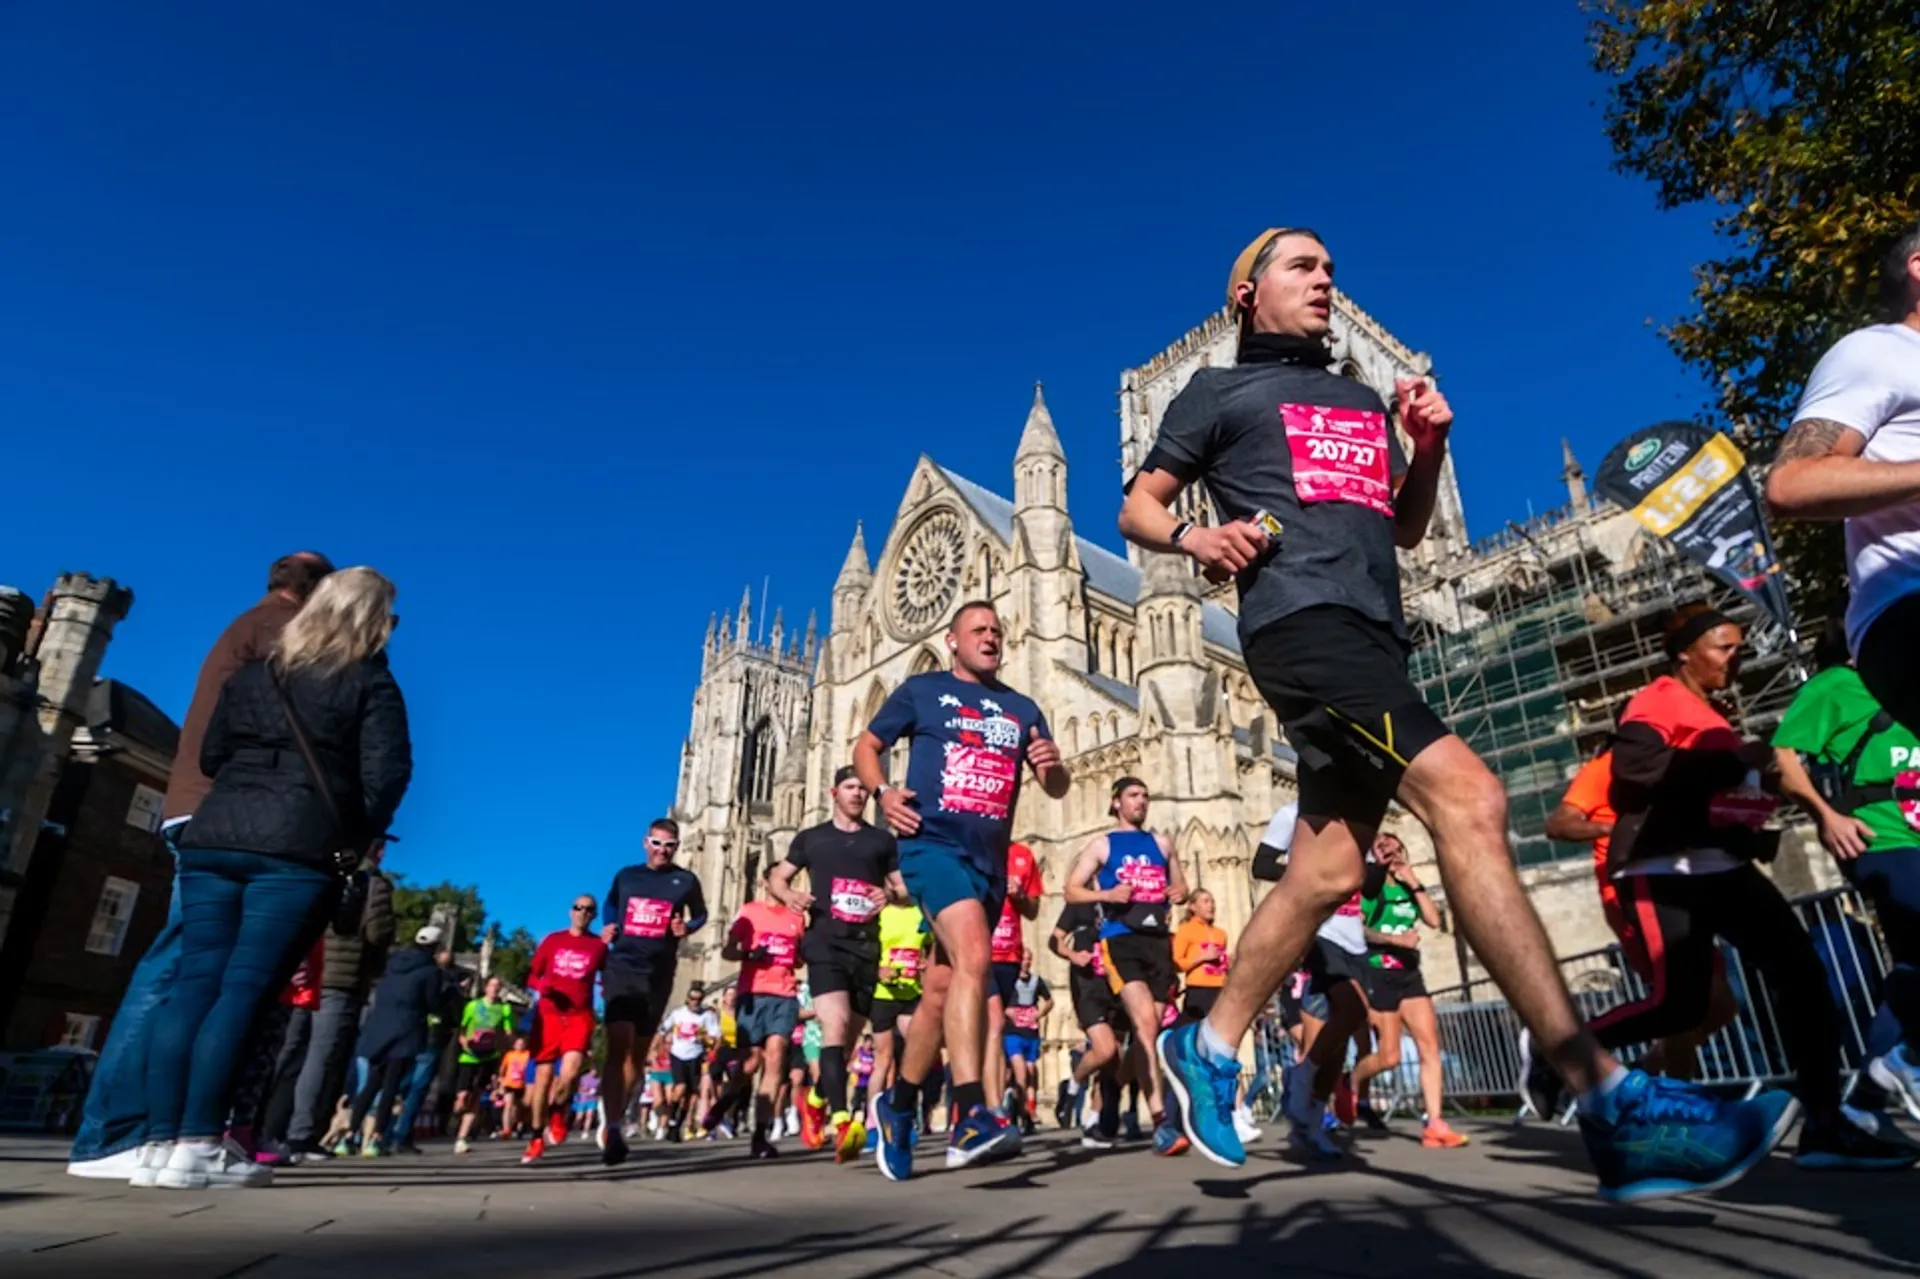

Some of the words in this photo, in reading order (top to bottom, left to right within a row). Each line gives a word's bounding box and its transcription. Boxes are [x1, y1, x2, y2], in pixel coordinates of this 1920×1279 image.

[1305, 438, 1375, 466] 20727
[1629, 440, 1690, 490] PROTEIN
[1643, 453, 1729, 529] 1:25
